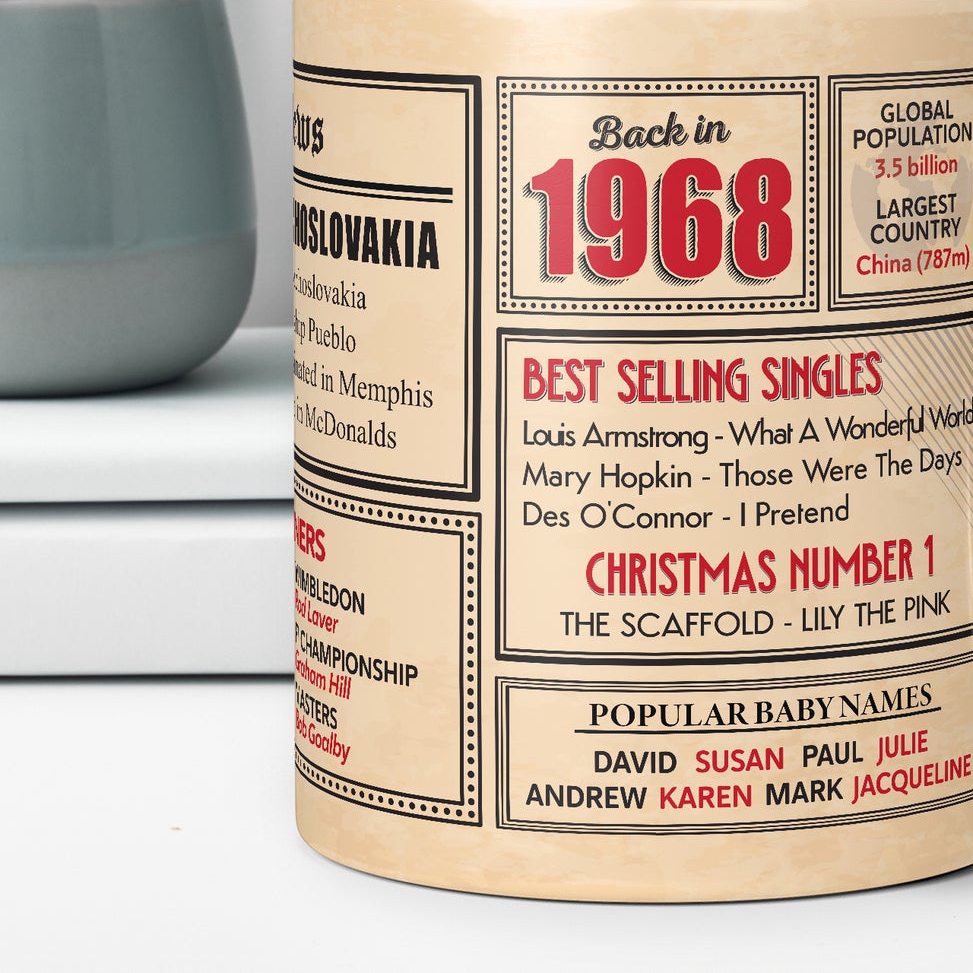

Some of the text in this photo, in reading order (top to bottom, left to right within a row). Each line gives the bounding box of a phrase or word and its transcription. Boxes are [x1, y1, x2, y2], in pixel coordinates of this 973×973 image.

[588, 111, 732, 151] Back in
[879, 99, 954, 124] GLOBAL
[853, 122, 973, 149] POPULATION
[875, 154, 958, 179] 3.5 billion
[522, 157, 794, 287] 1968
[876, 193, 957, 220] LARGEST
[870, 217, 961, 244] COUNTRY
[856, 244, 970, 276] China (787m)
[308, 317, 356, 353] Pueblo
[320, 364, 334, 393] in
[339, 369, 434, 411] Memphis
[523, 350, 884, 404] BEST SELLING SINGLES
[305, 403, 397, 449] McDonalds
[523, 420, 576, 447] Louis
[582, 421, 709, 455] Armstrong
[728, 417, 793, 446] What
[798, 417, 820, 444] A
[824, 405, 925, 442] Wonderful
[522, 460, 591, 495] Mary
[600, 460, 692, 495] Hopkin
[719, 458, 793, 487] Those
[802, 457, 867, 484] Were
[875, 449, 913, 478] The
[920, 447, 963, 476] Days
[523, 501, 570, 527] Des
[580, 500, 713, 529] O'Connor
[740, 502, 746, 527] I
[756, 493, 850, 527] Pretend
[585, 534, 934, 596] CHRISTMAS NUMBER 1
[307, 600, 339, 634] Laver
[560, 611, 610, 636] THE
[621, 609, 774, 637] SCAFFOLD
[802, 604, 845, 632] LILY
[854, 598, 896, 627] THE
[904, 589, 951, 621] PINK
[300, 629, 418, 687] CHAMPIONSHIP
[328, 672, 352, 700] Hill
[588, 682, 932, 727] POPULAR BABY NAMES
[308, 722, 351, 765] Goalby
[594, 729, 929, 774] DAVID SUSAN PAUL JULIE
[525, 753, 972, 810] ANDREW KAREN MARK JACQUELINE
